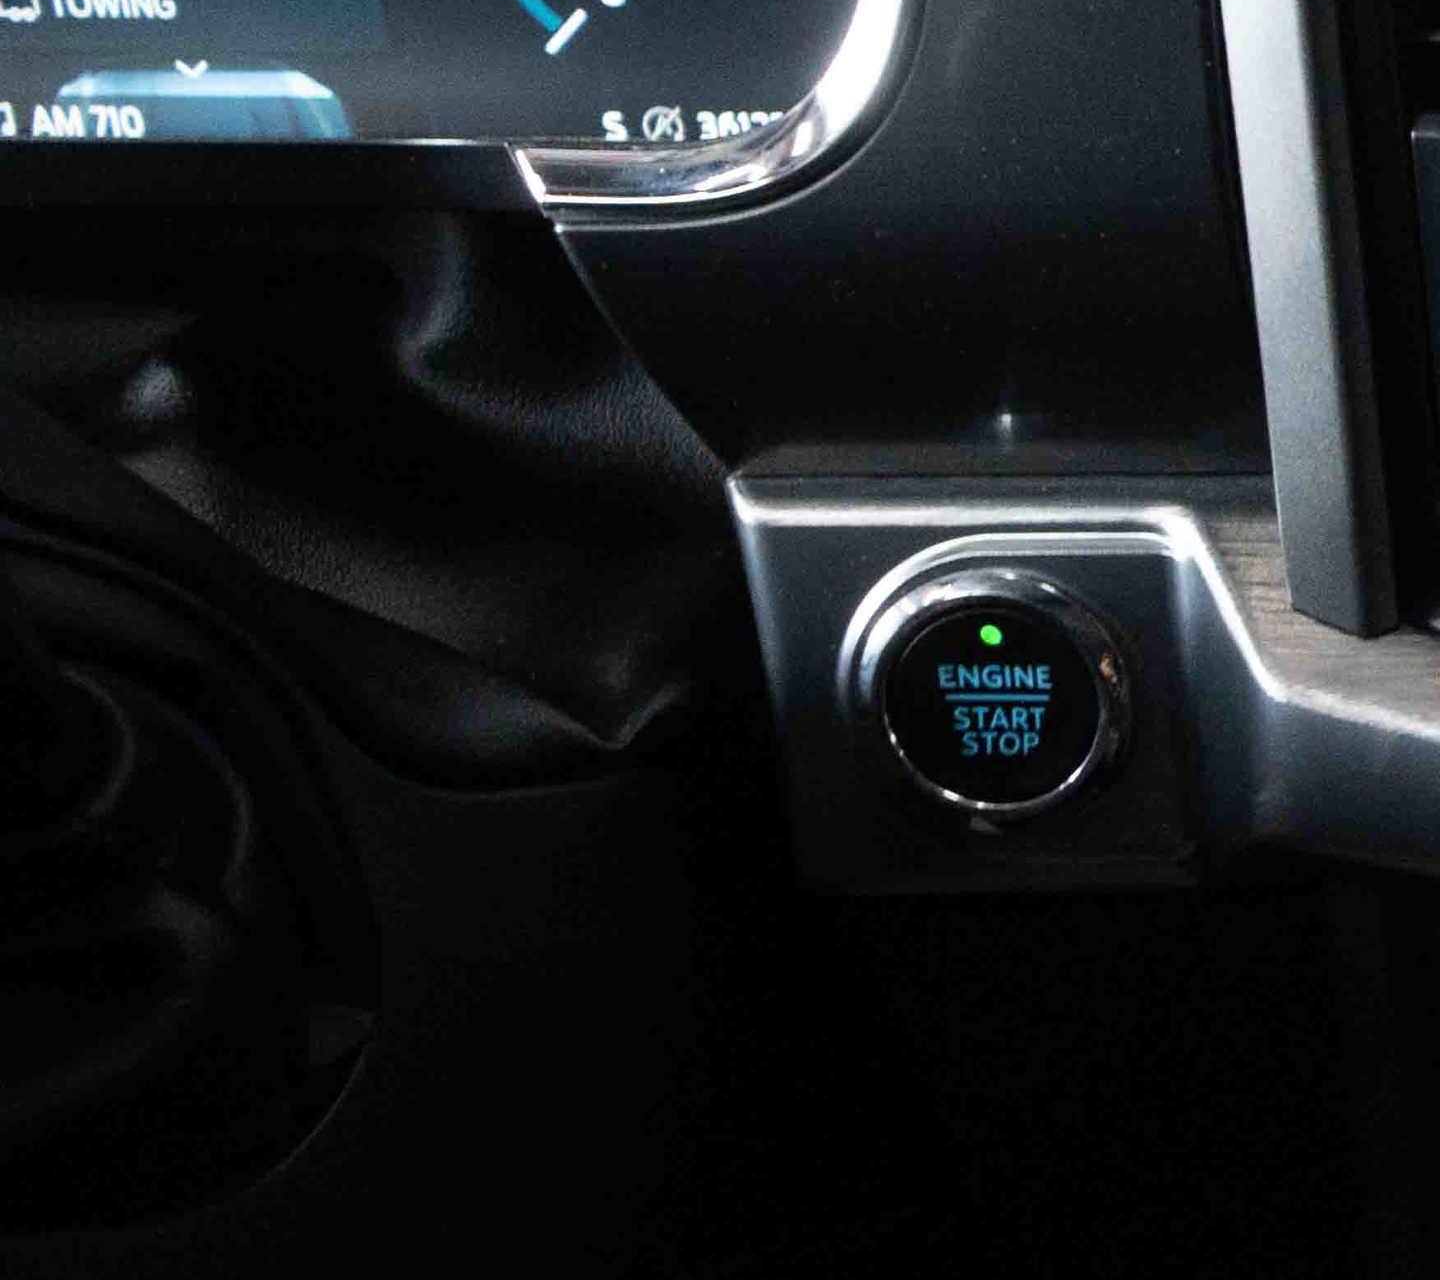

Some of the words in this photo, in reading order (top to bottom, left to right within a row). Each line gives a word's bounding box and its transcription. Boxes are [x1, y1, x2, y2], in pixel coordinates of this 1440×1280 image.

[33, 104, 86, 138] AM
[88, 104, 146, 138] 710
[602, 110, 629, 142] S
[937, 664, 1053, 689] ENGINE
[954, 706, 1045, 731] START
[962, 731, 1040, 756] STOP
